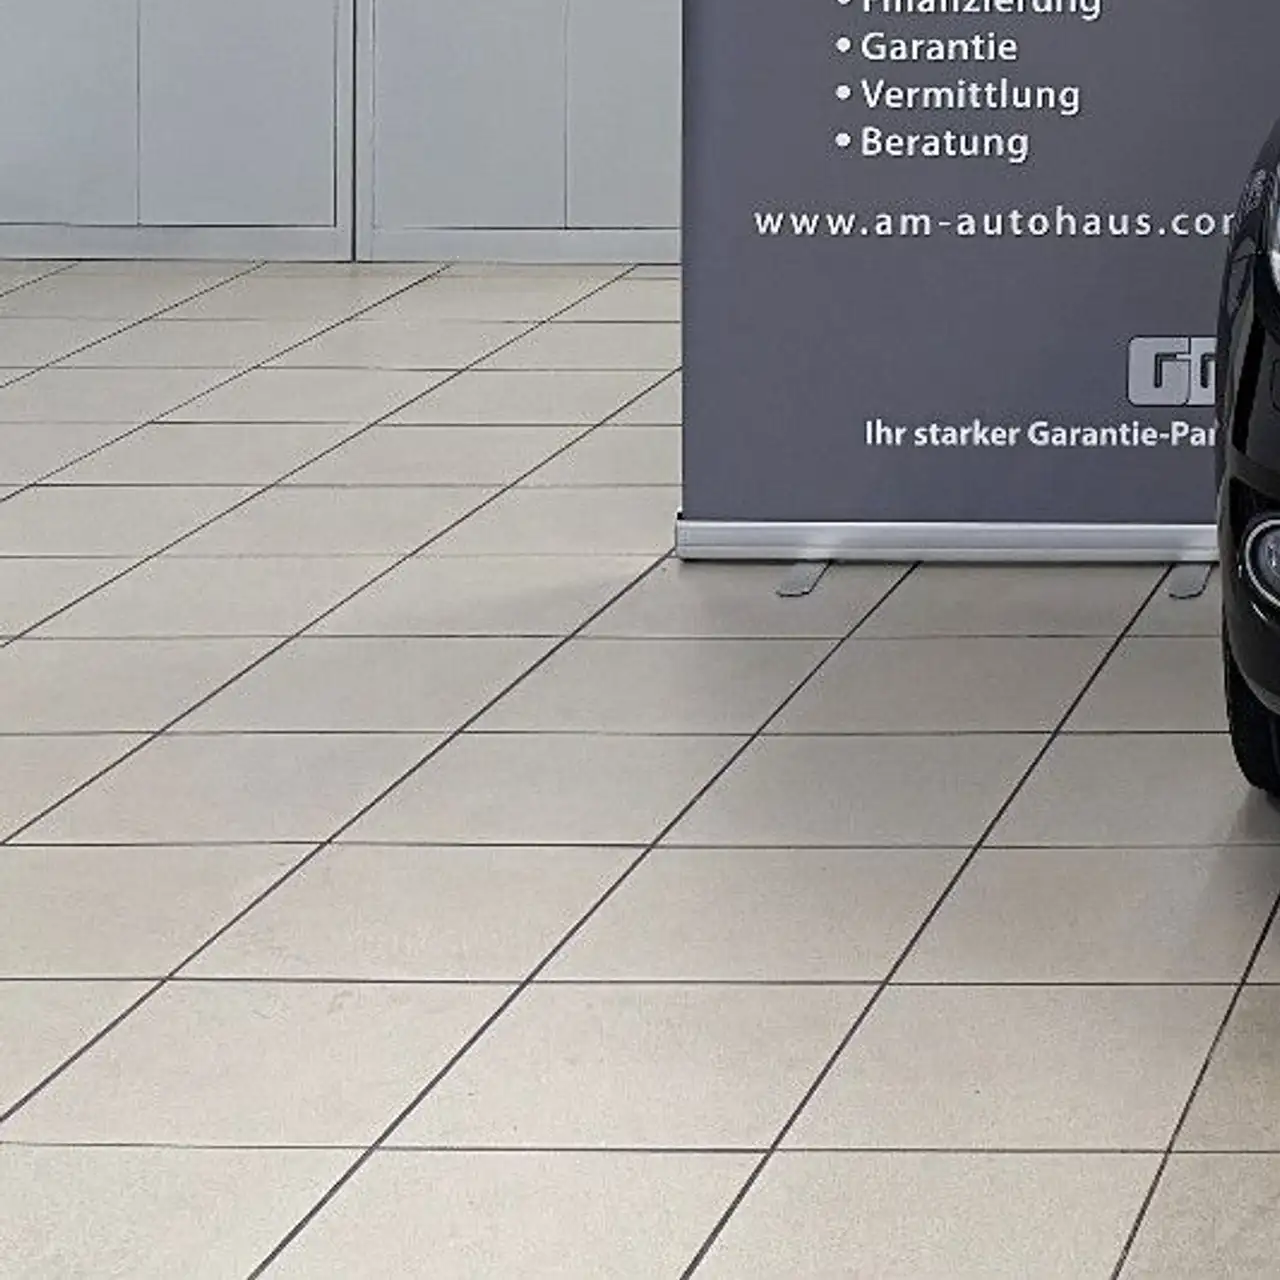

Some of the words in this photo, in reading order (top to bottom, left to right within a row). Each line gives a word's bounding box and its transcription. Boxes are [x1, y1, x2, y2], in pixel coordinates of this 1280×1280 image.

[860, 30, 1019, 61] Garantie
[859, 76, 1080, 117] Vermittlung
[860, 125, 1030, 164] Beratung
[865, 417, 908, 447] Ihr
[913, 417, 1022, 448] starker
